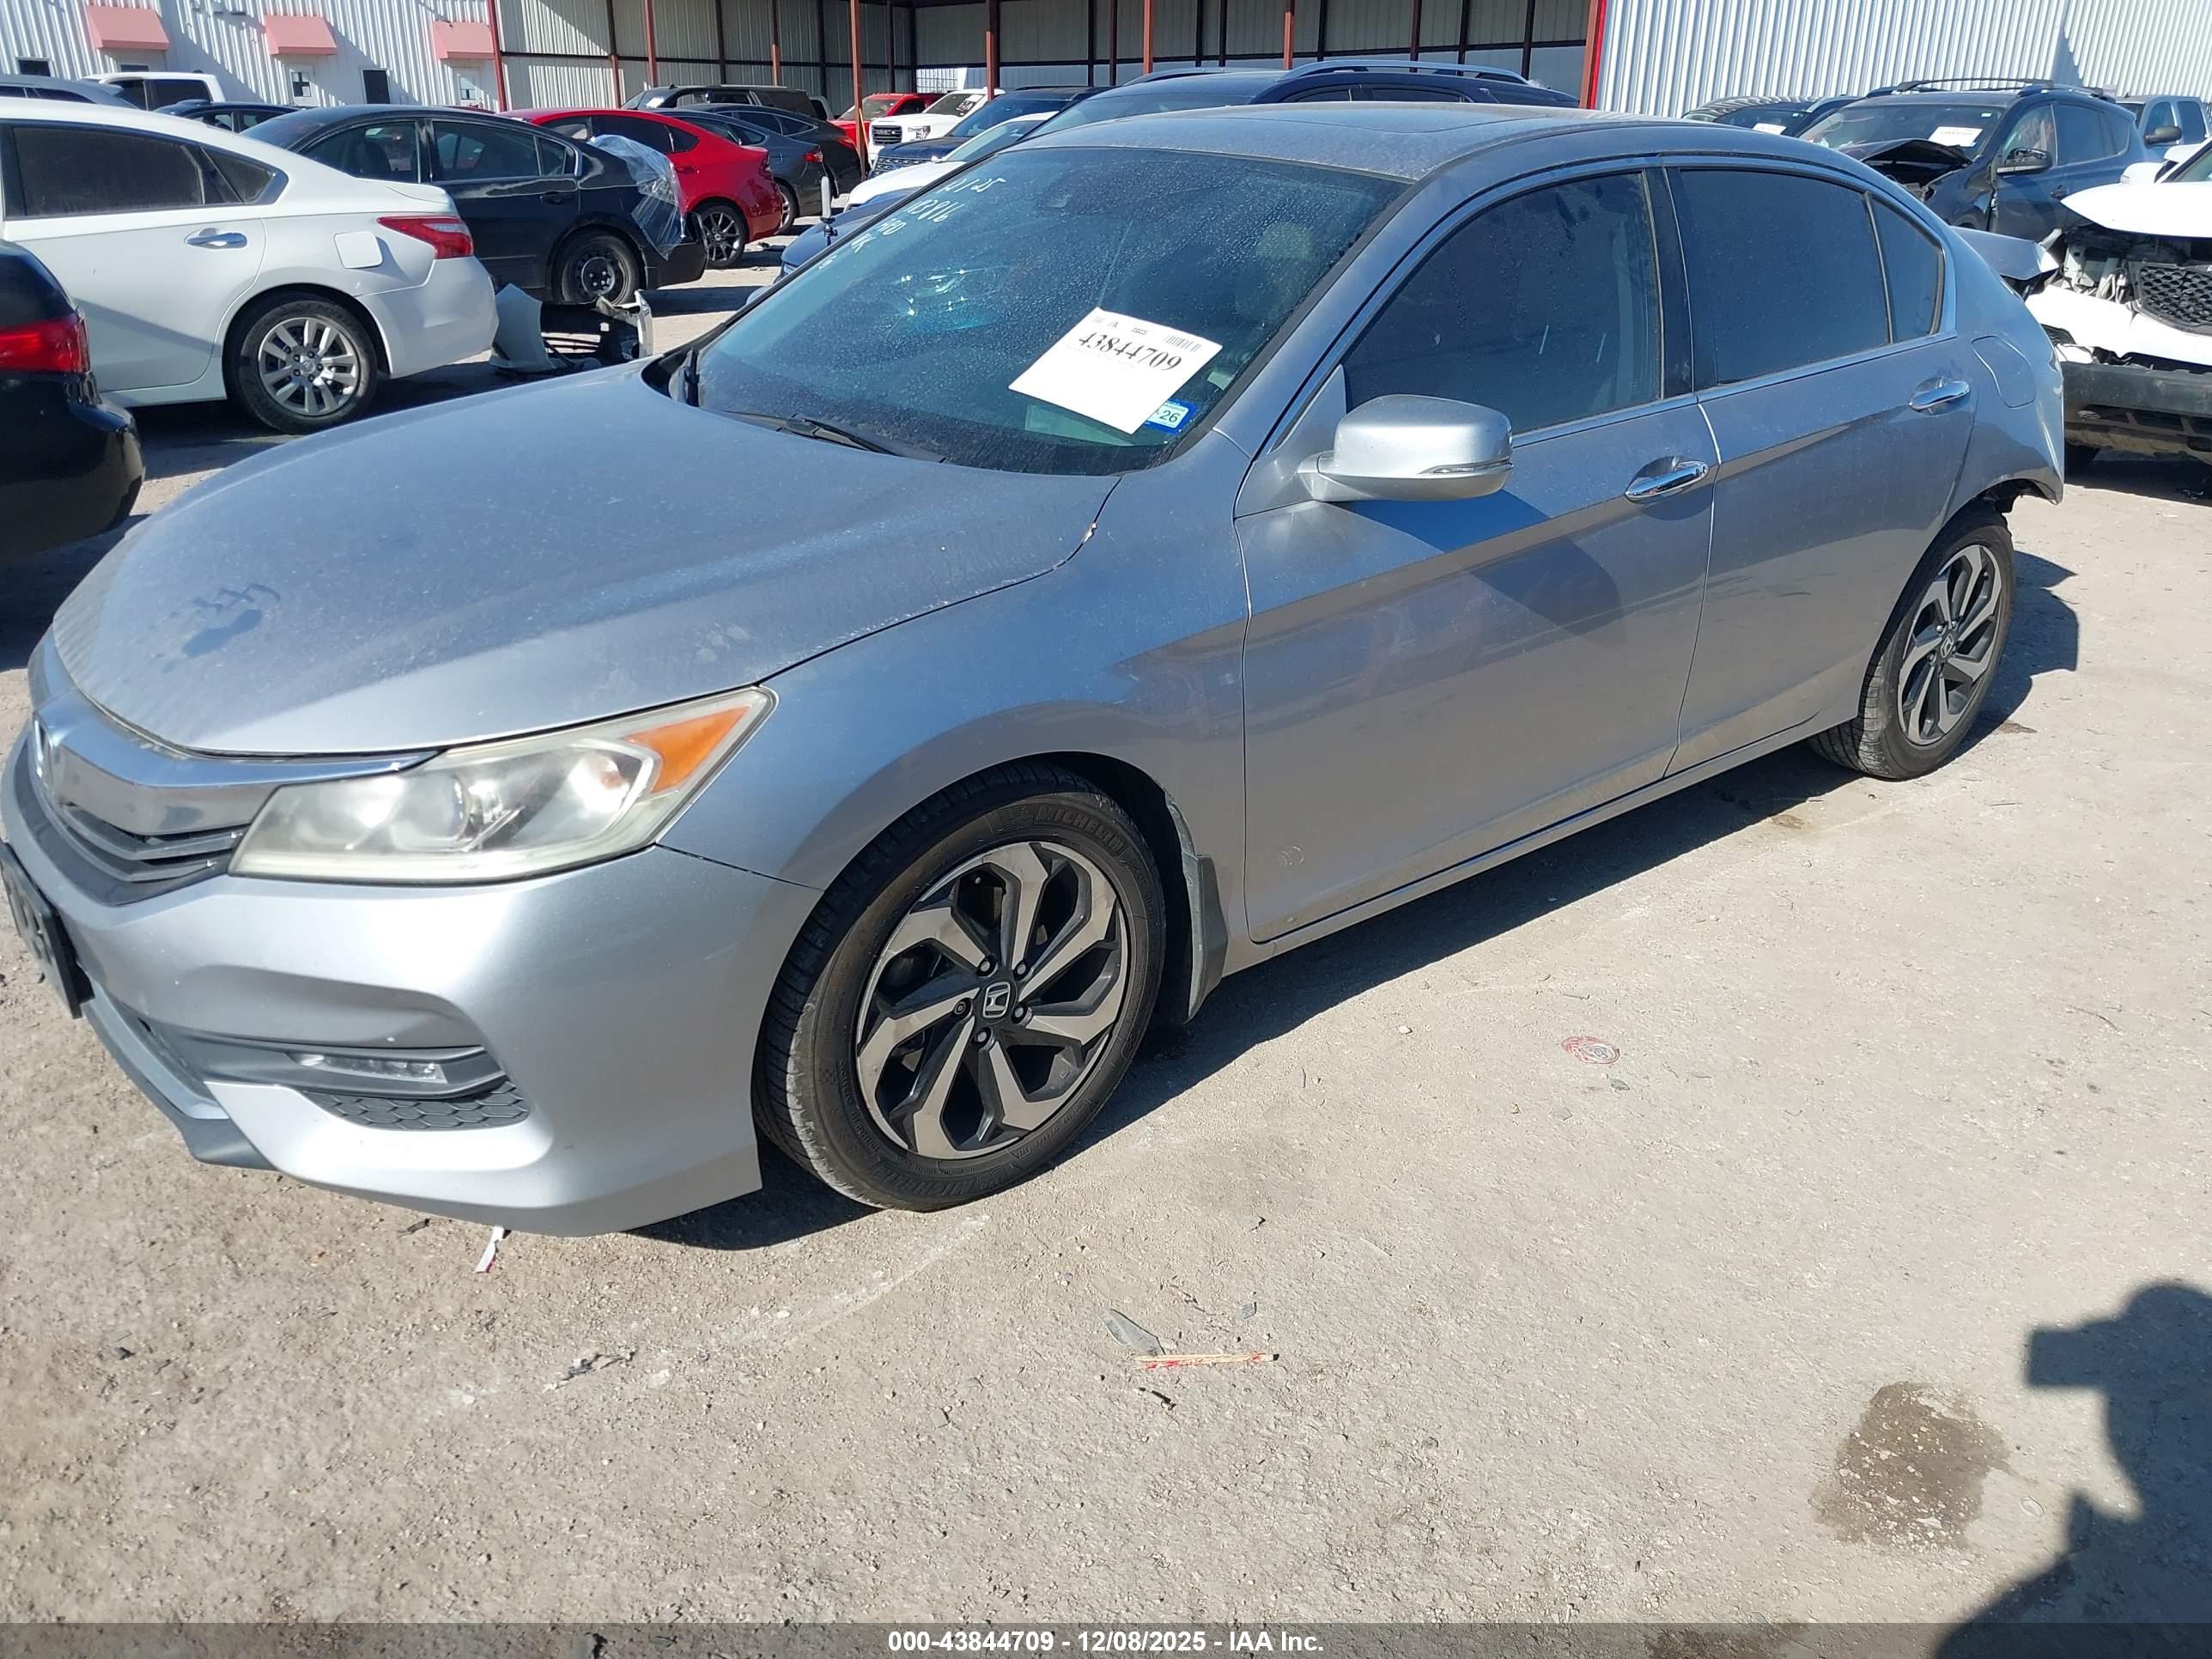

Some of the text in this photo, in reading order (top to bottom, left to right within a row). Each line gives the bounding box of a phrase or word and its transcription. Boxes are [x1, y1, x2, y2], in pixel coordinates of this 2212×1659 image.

[1079, 331, 1182, 371] 43844709
[1159, 410, 1181, 422] 26
[1035, 808, 1126, 855] MICHELIN
